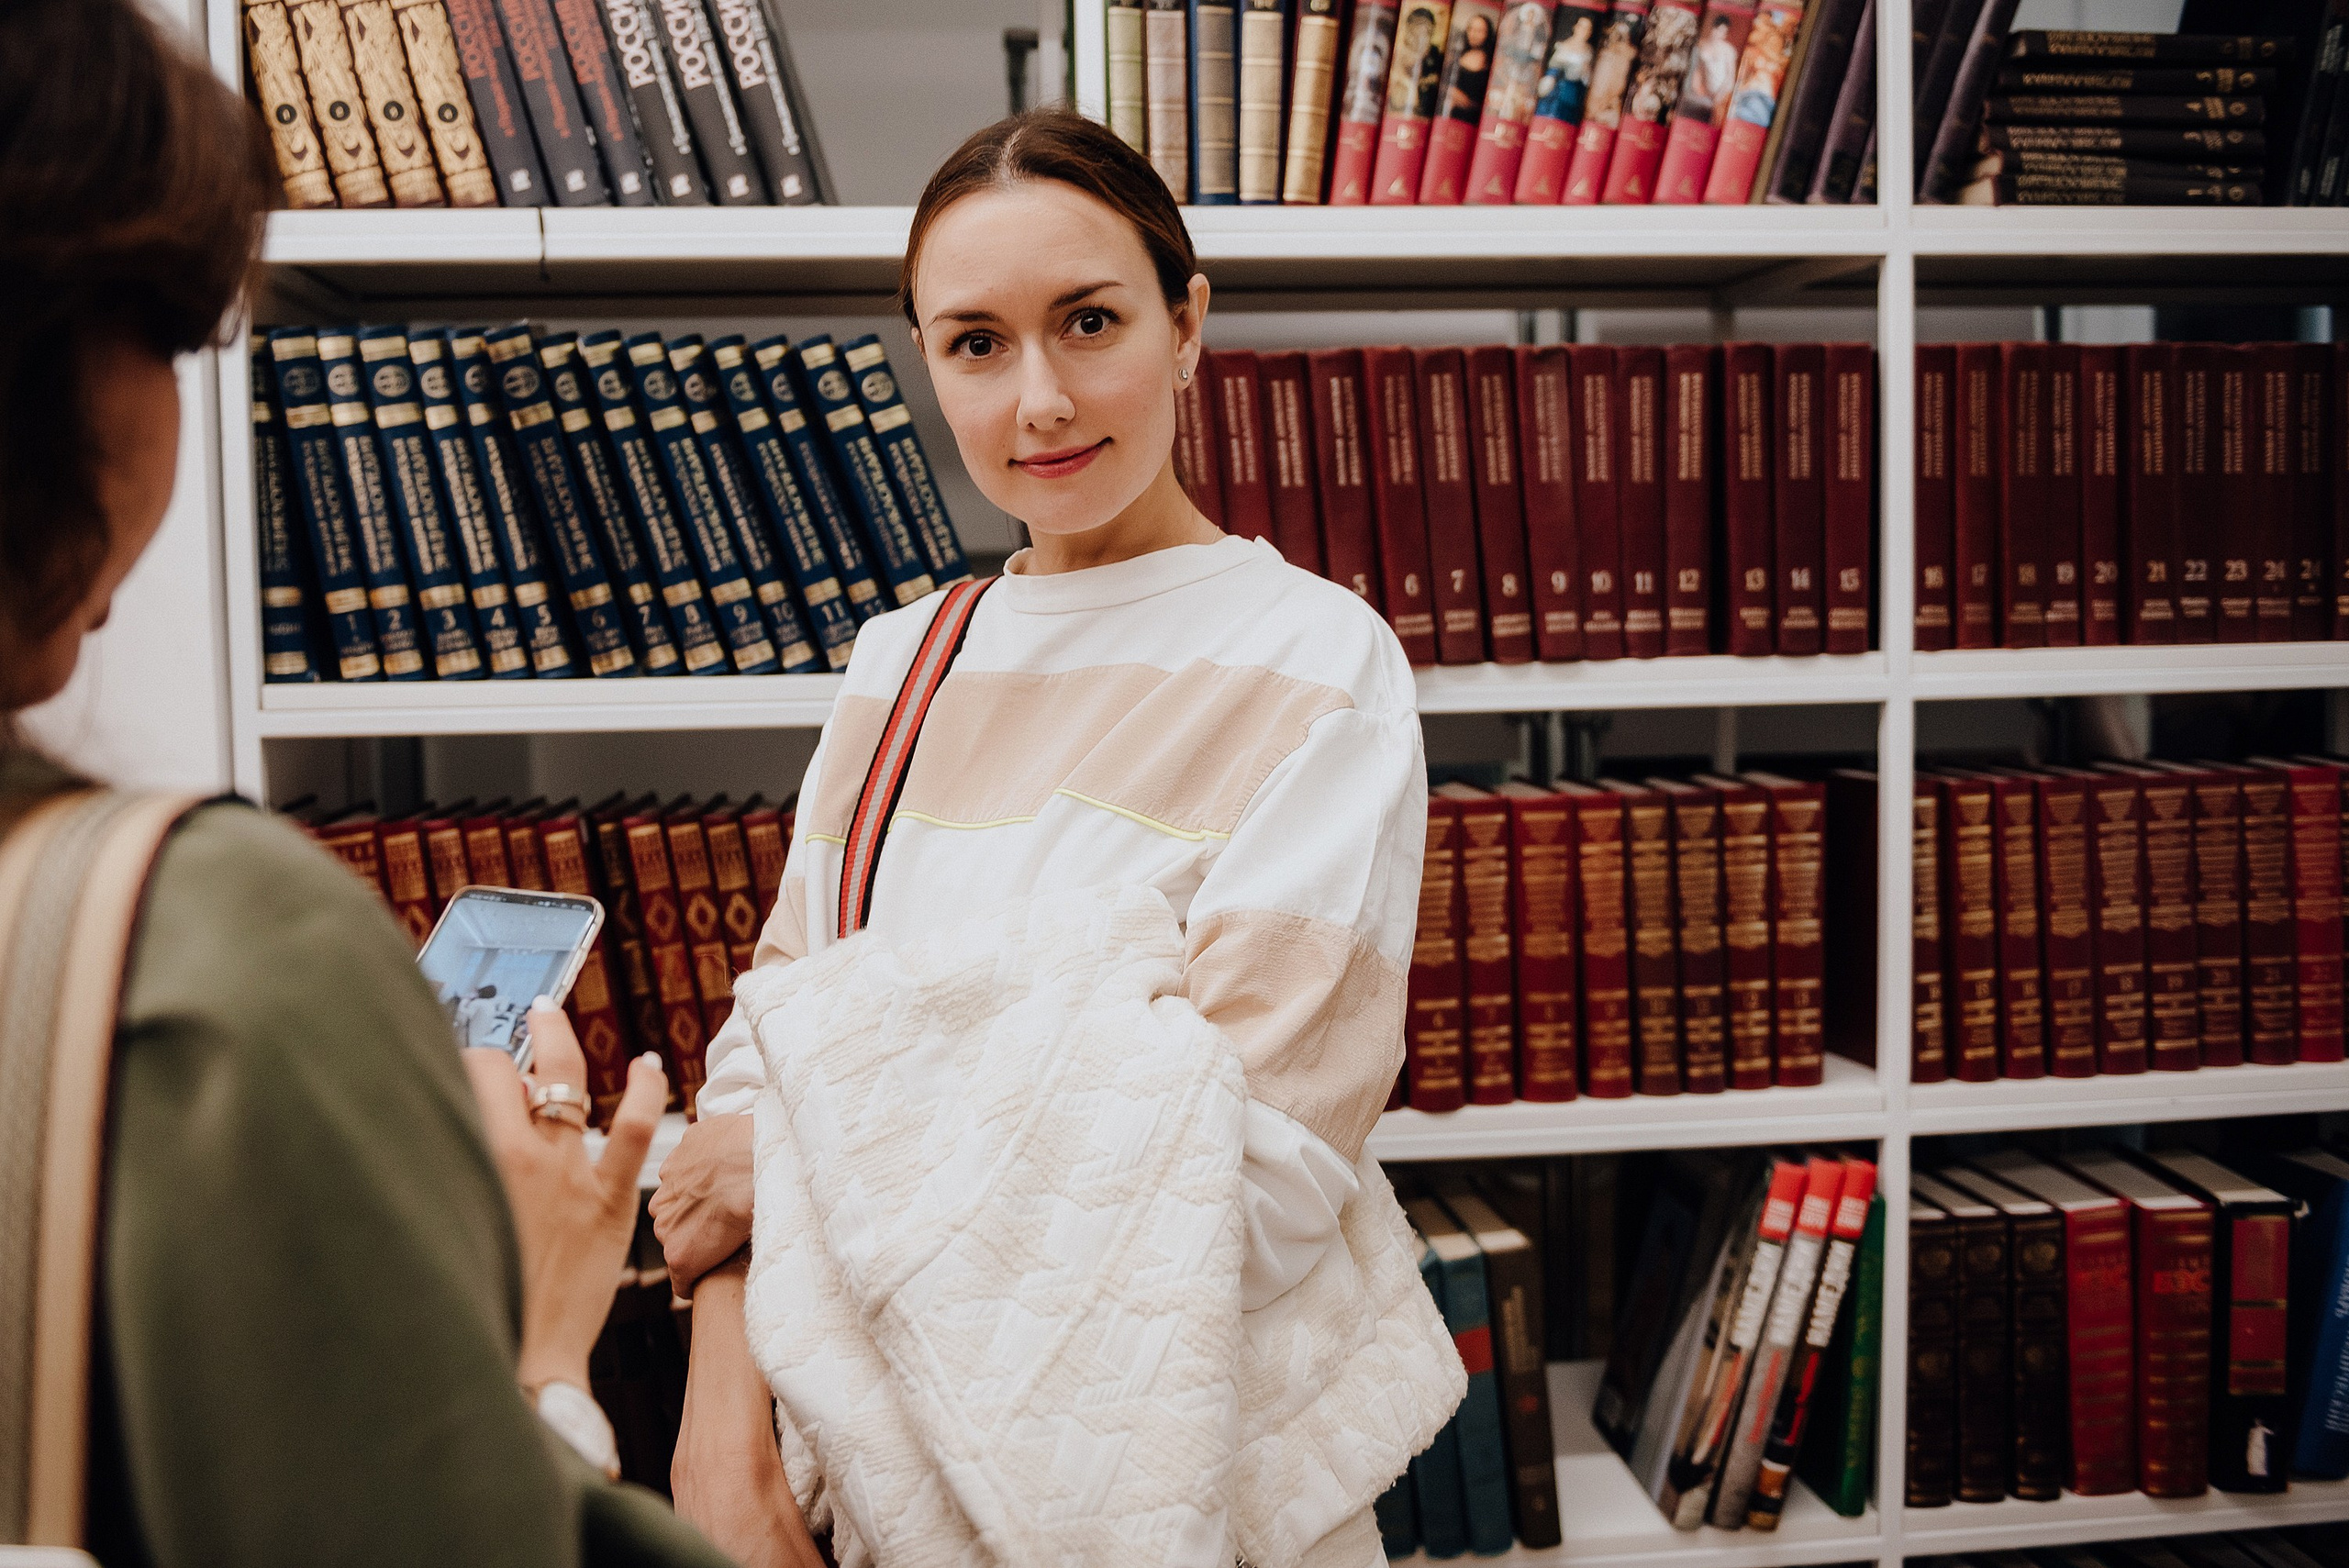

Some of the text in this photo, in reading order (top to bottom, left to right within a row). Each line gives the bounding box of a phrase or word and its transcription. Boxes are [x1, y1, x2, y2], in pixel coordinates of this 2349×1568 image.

[1450, 569, 1464, 593] 7
[1551, 570, 1567, 594] 9
[1591, 570, 1611, 594] 10
[1679, 568, 1699, 593] 12
[2094, 560, 2118, 584] 20
[2146, 560, 2167, 582] 21
[2185, 559, 2207, 582] 22
[2225, 559, 2248, 582] 23
[1404, 573, 1419, 596] 6
[1501, 573, 1517, 597] 8
[1634, 571, 1652, 595] 11
[387, 609, 403, 630] 2
[441, 608, 457, 630] 3
[491, 607, 506, 628] 4
[537, 605, 551, 627] 5
[592, 609, 607, 628] 6
[638, 605, 651, 625] 7
[685, 604, 700, 625] 8
[733, 604, 748, 624] 9
[772, 602, 795, 624] 10
[821, 601, 845, 624] 11
